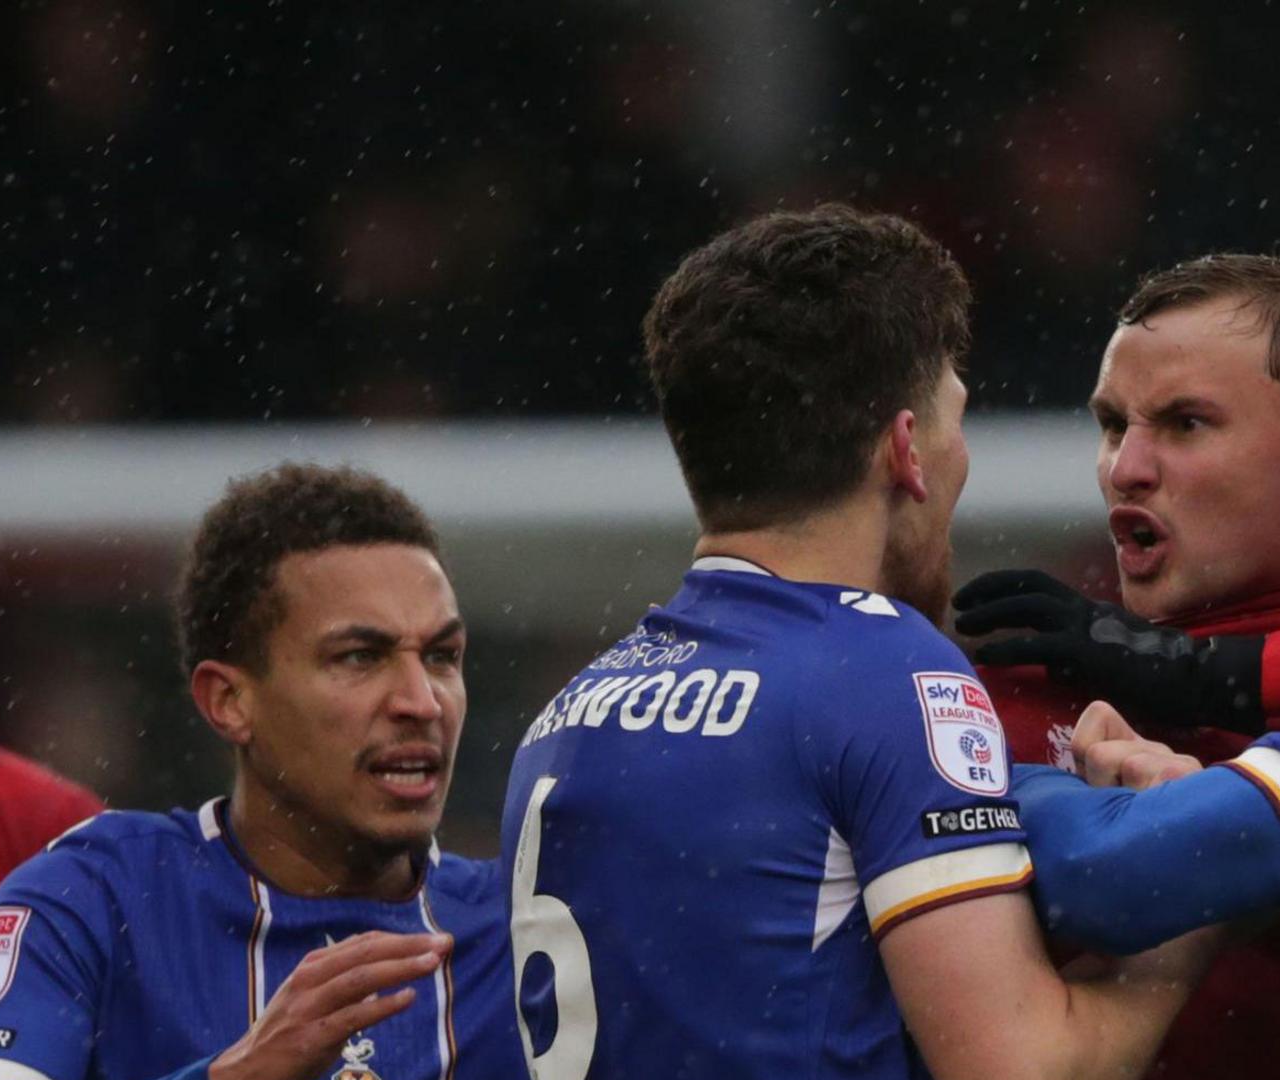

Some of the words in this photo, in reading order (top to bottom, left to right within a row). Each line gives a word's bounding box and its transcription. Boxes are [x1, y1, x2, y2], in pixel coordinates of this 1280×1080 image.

[928, 683, 959, 702] sky
[933, 707, 974, 721] LEAGUE
[969, 767, 995, 783] EFL
